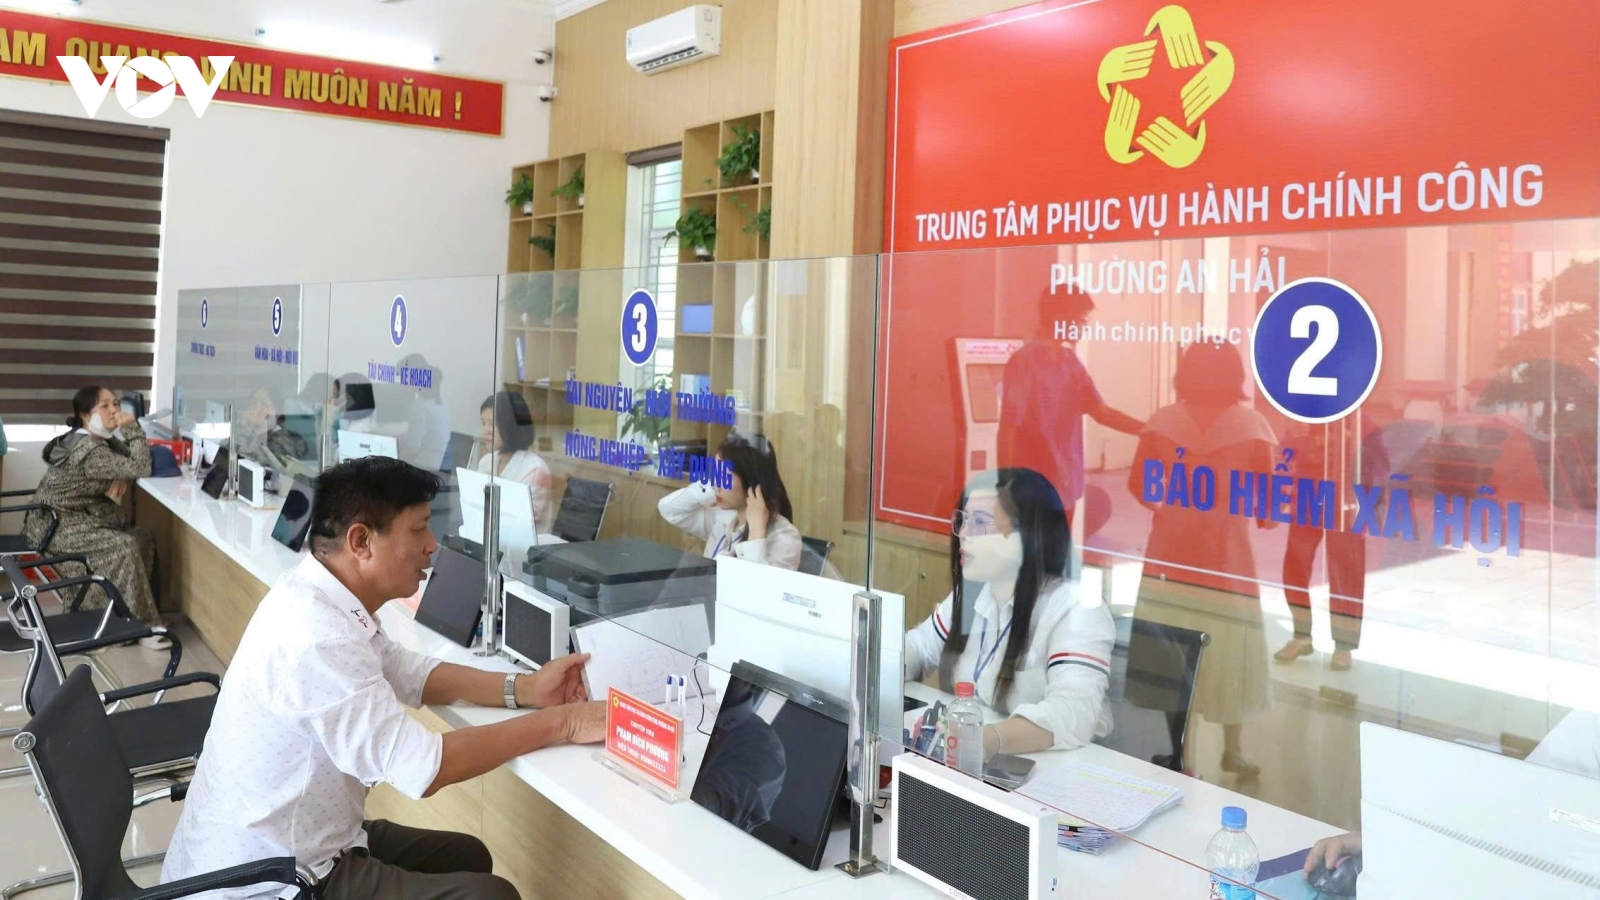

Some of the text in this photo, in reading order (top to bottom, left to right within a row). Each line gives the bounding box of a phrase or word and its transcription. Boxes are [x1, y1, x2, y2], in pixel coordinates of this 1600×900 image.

[284, 67, 369, 108] MUÔN
[378, 77, 442, 118] NĂM
[454, 91, 463, 120] !
[916, 161, 1544, 242] TRUNG TÂM PHỤC VỤ HÀNH CHÍNH CÔNG
[1050, 246, 1285, 295] PHƯỜNG AN HẢI
[394, 304, 402, 338] 4
[631, 303, 648, 353] 3
[1053, 320, 1106, 341] Hành
[1111, 321, 1174, 343] chính
[1180, 322, 1242, 350] phục
[368, 358, 377, 380] TÀI
[377, 361, 395, 383] CHÍNH
[401, 359, 408, 385] KẾ
[409, 367, 432, 391] HOẠCH
[1288, 304, 1340, 396] 2
[565, 375, 582, 406] TÀI
[585, 381, 633, 414] NGUYÊN
[676, 386, 736, 425] TRƯỜNG
[565, 428, 598, 460] NÔNG
[600, 438, 644, 476] NGHIỆP
[657, 445, 685, 480] XÂY
[689, 454, 733, 493] DỰNG
[1142, 447, 1522, 568] BẢO HIỂM XÃ HỘI
